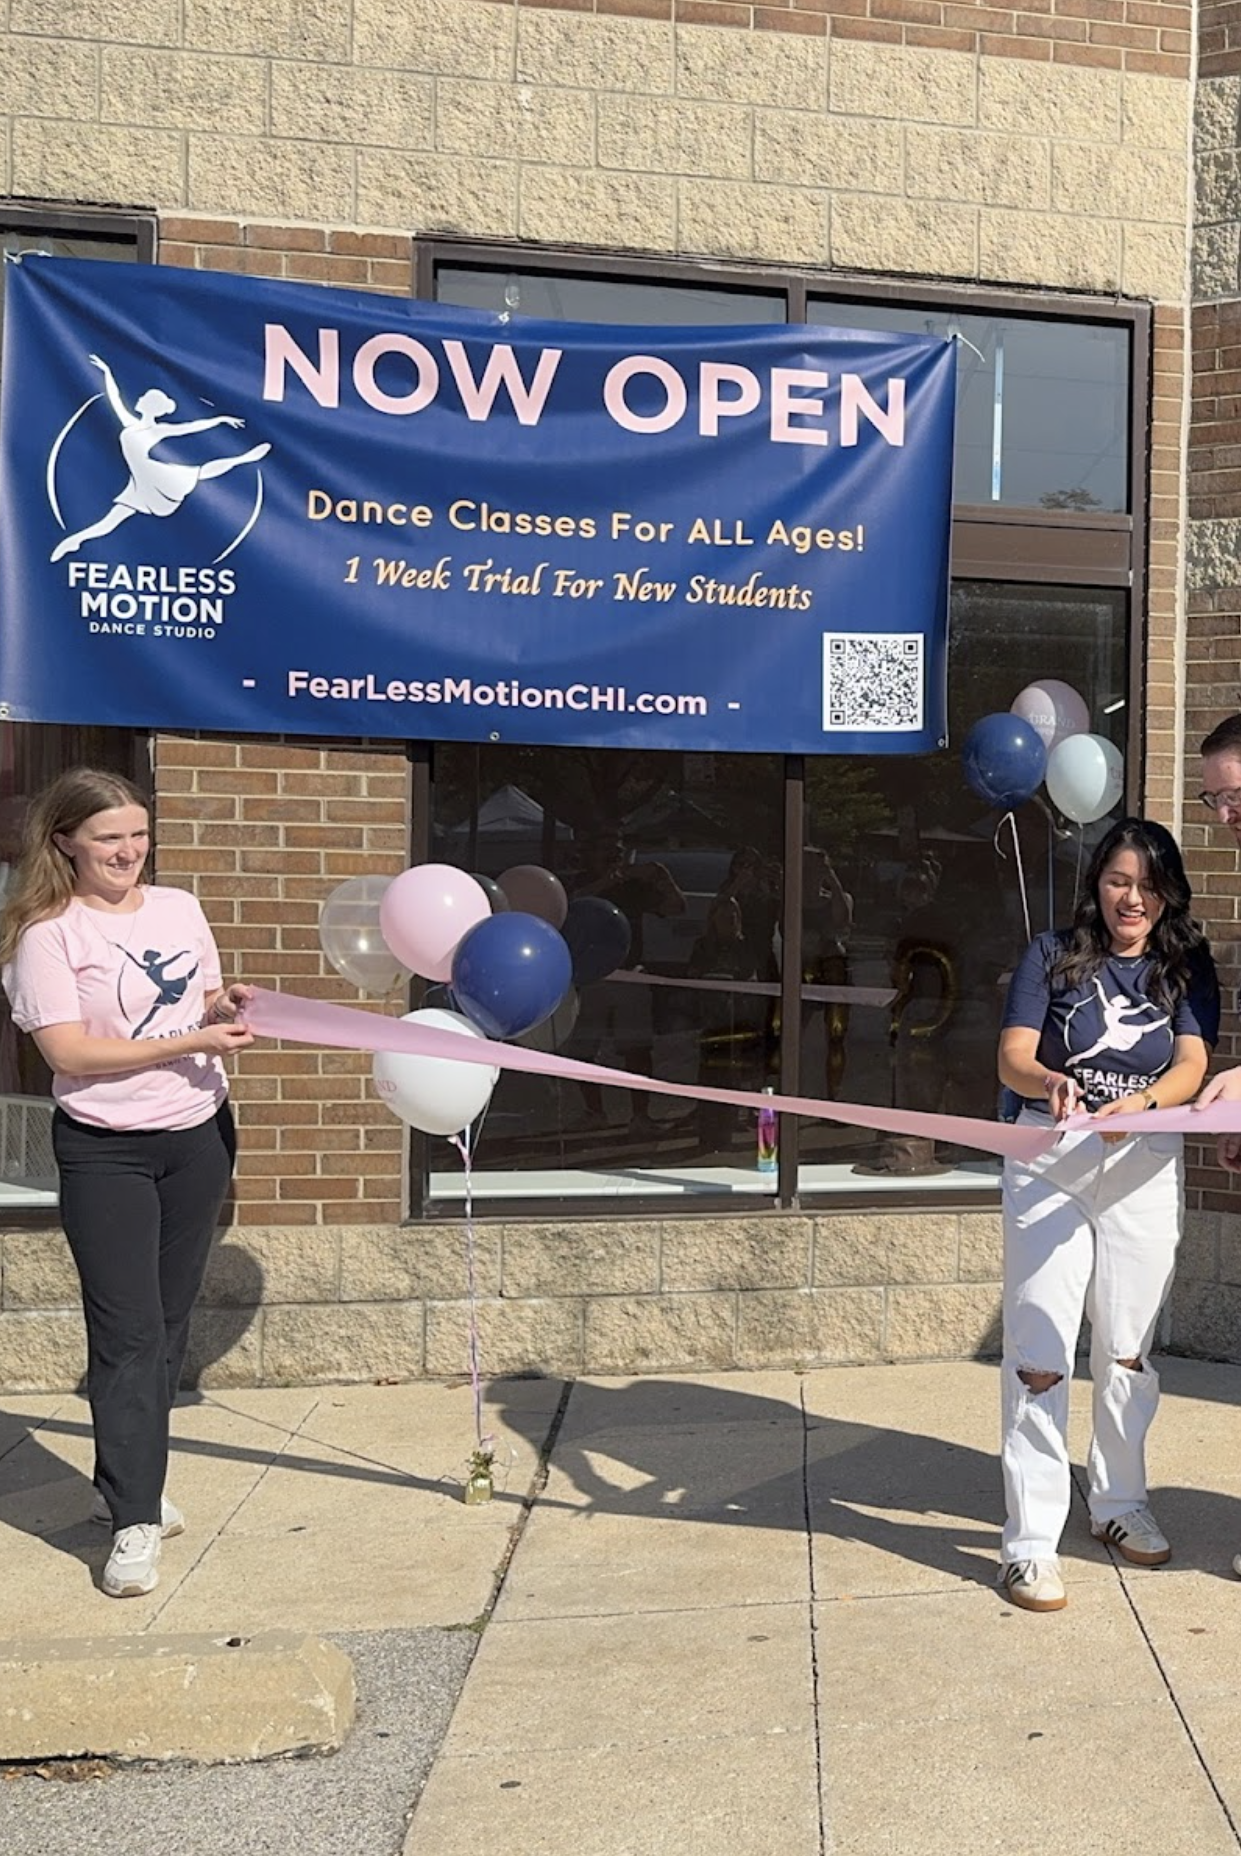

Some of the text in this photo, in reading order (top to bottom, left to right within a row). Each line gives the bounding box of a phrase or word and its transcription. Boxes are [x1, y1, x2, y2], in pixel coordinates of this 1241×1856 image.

[263, 322, 906, 447] NOW OPEN
[307, 490, 865, 554] Dance Classes For ALL Ages!
[68, 562, 236, 595] FEARLESS
[343, 555, 813, 611] 1 Week Trial For New Students
[81, 592, 224, 624] MOTION
[89, 621, 216, 640] DANCE STUDIO
[287, 670, 708, 716] FearLessMotionCHI.com
